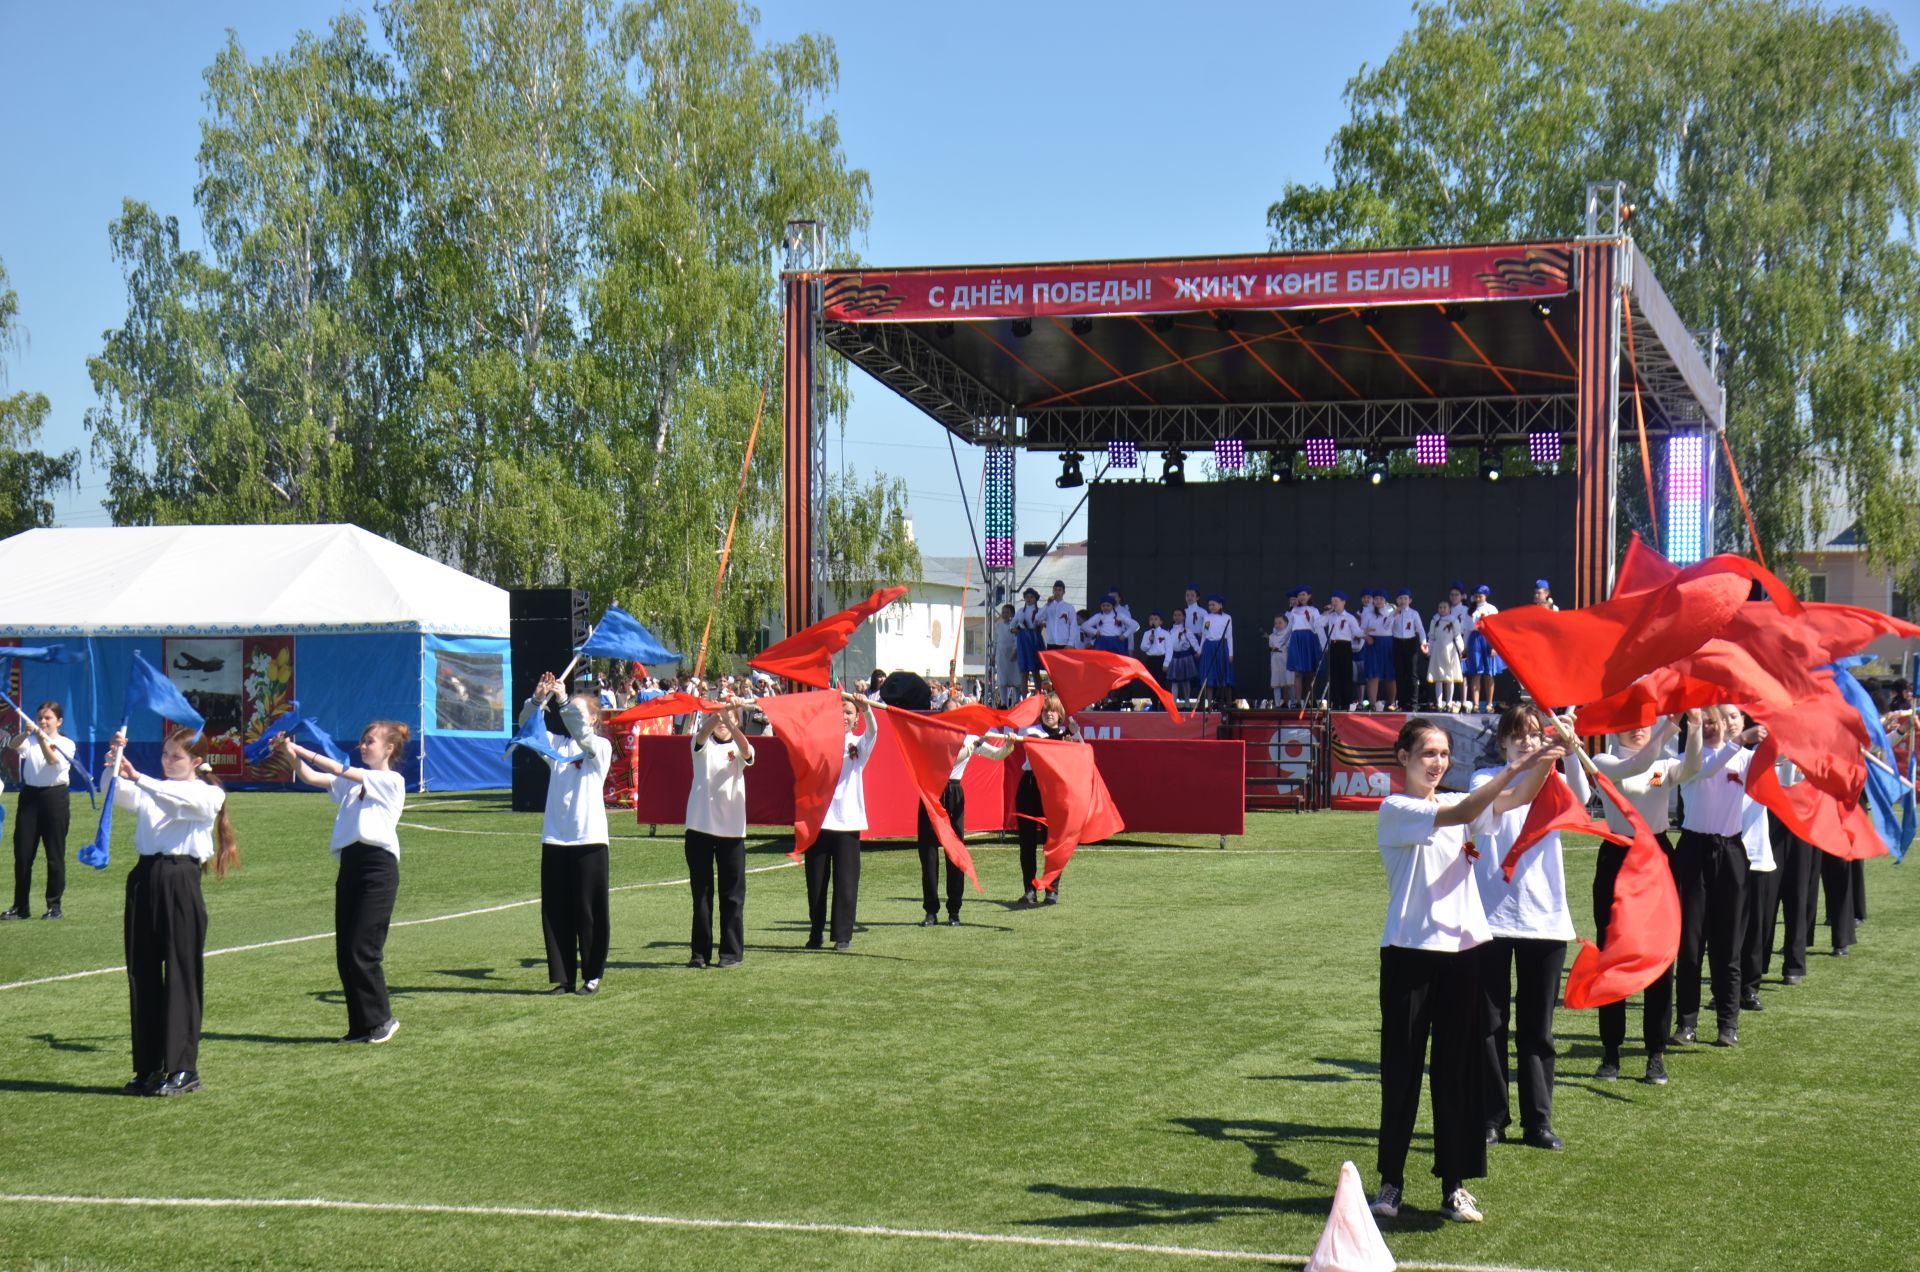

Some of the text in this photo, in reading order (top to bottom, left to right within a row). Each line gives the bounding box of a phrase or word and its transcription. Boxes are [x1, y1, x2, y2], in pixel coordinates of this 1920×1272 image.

[928, 286, 945, 308] С
[951, 280, 1024, 311] ДНЁМ
[1032, 279, 1152, 306] ПОБЕДЫ!
[1265, 271, 1338, 297] КӨНЕ
[1346, 265, 1450, 292] БЕЛӘН!
